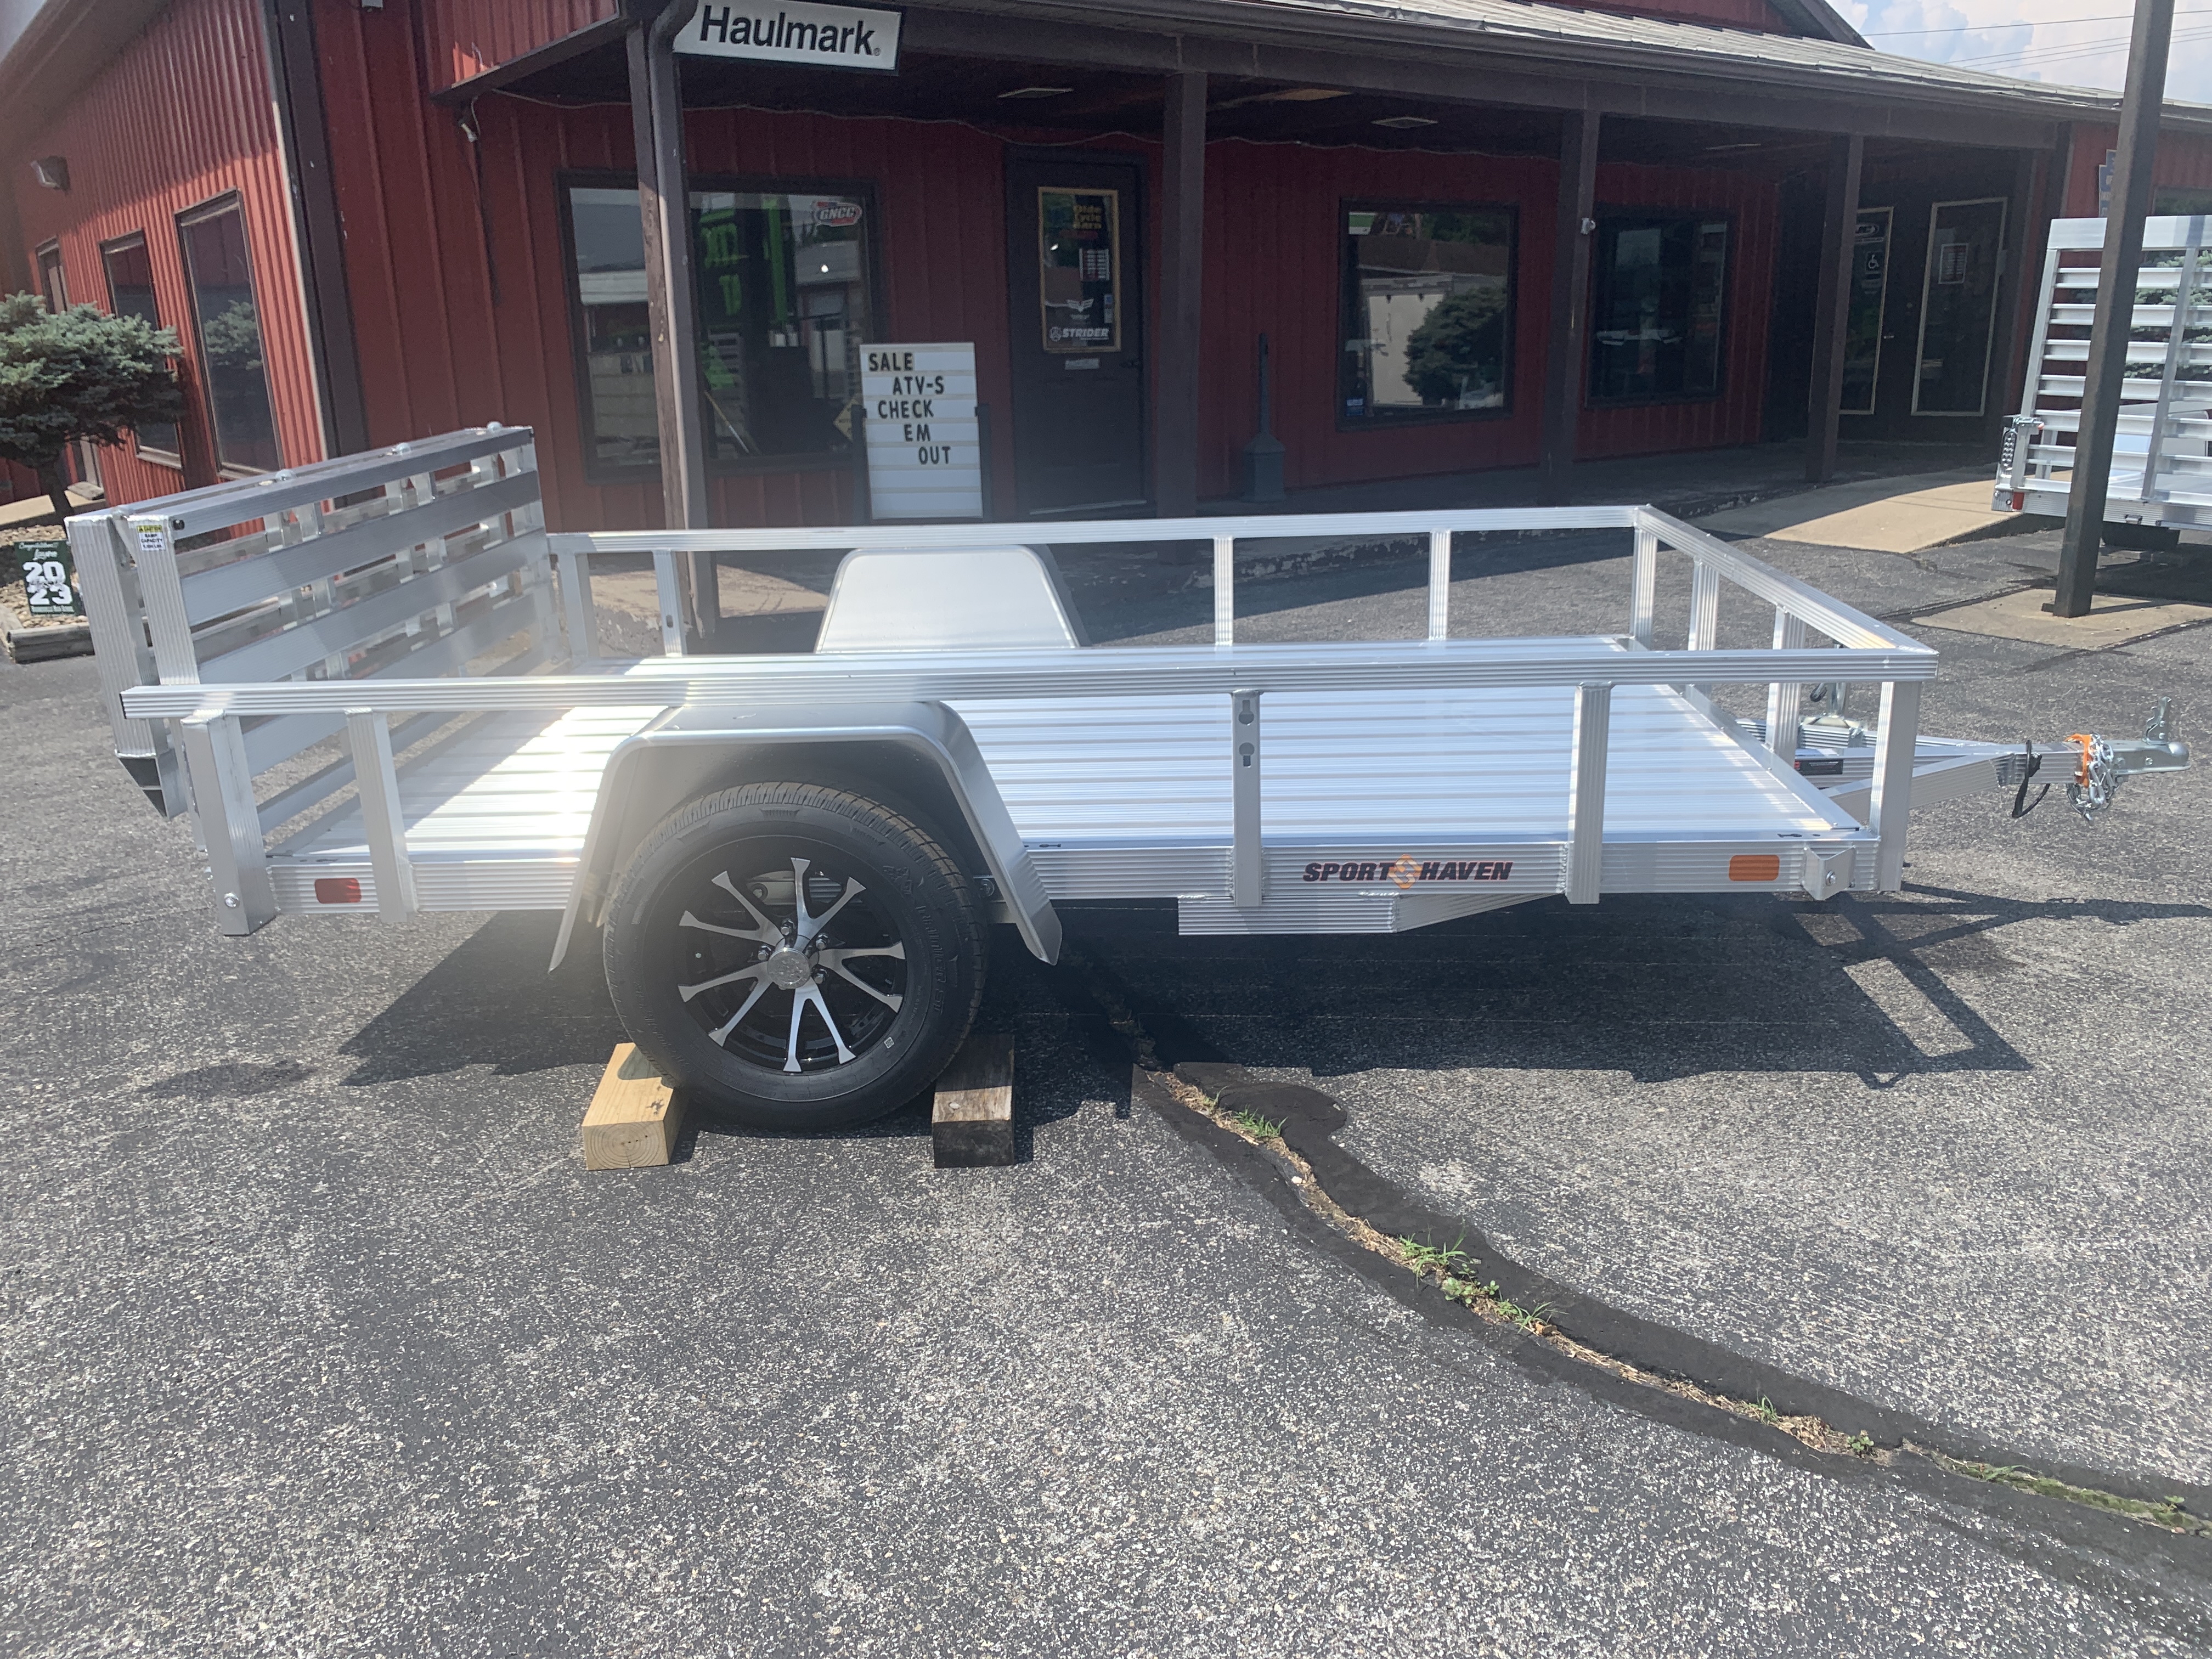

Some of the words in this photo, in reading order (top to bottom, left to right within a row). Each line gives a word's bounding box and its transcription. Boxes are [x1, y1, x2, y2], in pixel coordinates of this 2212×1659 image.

[700, 5, 875, 56] Haulmark
[1062, 328, 1109, 337] STRIDER
[869, 352, 913, 371] SALE
[893, 376, 945, 395] ATV-S
[878, 399, 934, 419] CHECK
[904, 424, 931, 442] EM
[918, 446, 951, 464] OUT
[22, 561, 66, 583] 20
[27, 583, 73, 605] 23
[1303, 862, 1397, 881] SPORT
[1419, 861, 1514, 881] HAVEN
